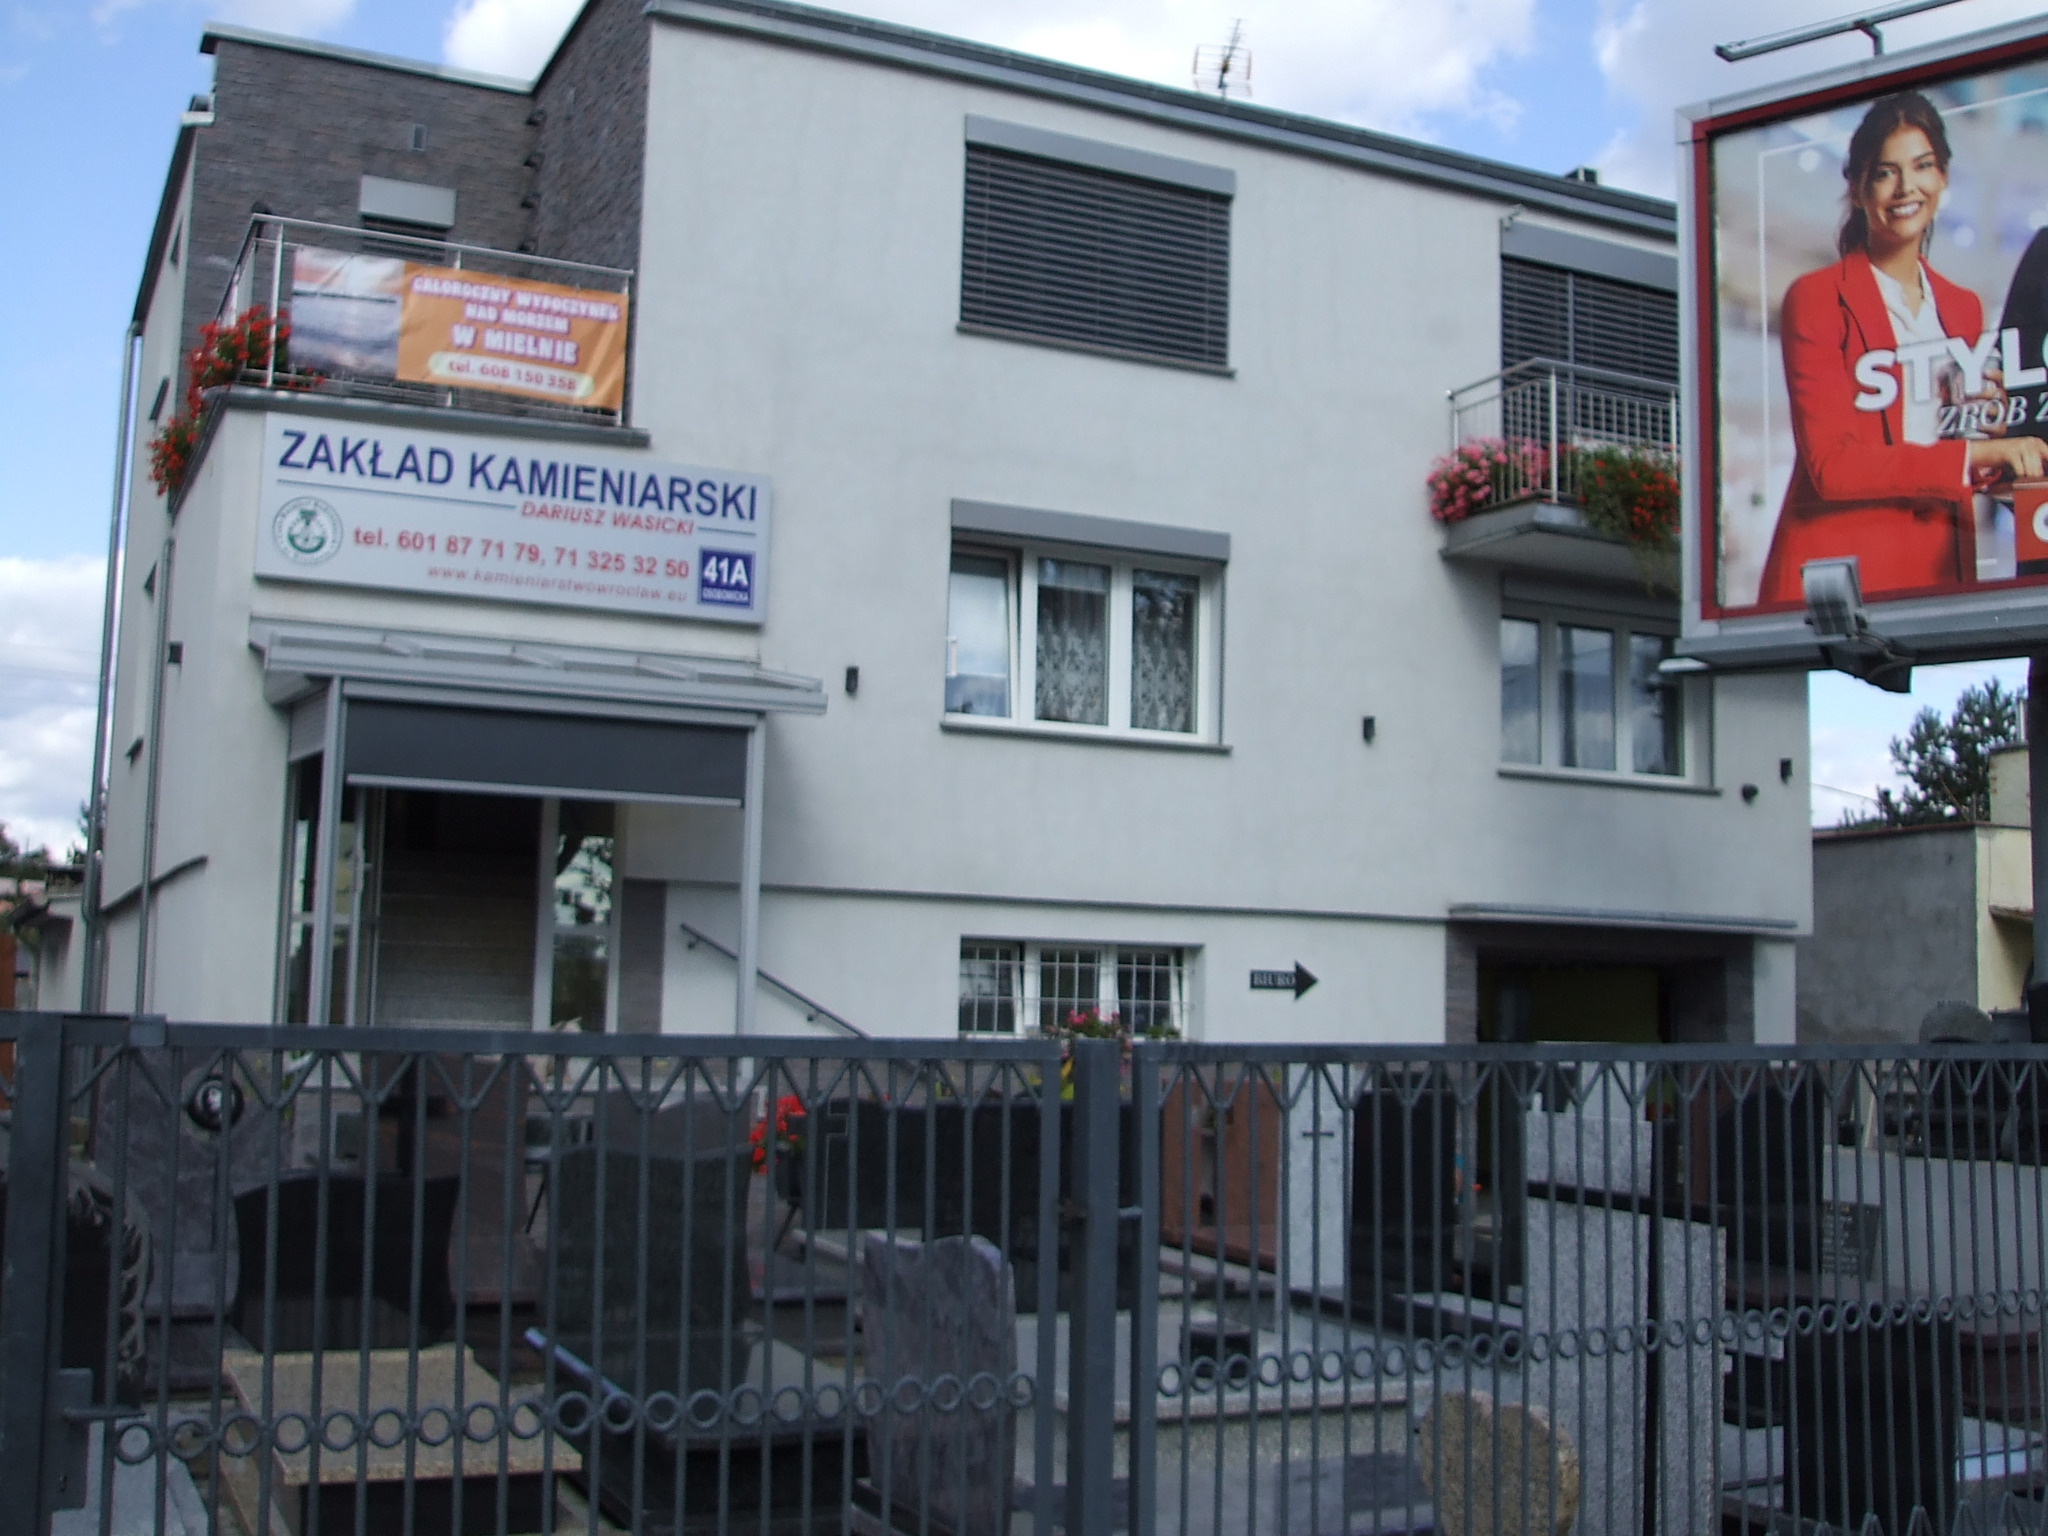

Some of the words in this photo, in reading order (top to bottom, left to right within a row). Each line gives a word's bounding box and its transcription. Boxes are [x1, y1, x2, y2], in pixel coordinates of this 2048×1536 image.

[465, 302, 499, 322] NAD
[501, 308, 570, 334] MORZEM
[515, 290, 620, 321] WYPOCZYNEK
[452, 323, 477, 348] W
[484, 328, 579, 365] MIELNIE
[448, 360, 474, 373] tel.
[517, 366, 544, 384] 150
[1854, 327, 2048, 412] STYL
[278, 429, 455, 485] ZAKŁAD
[469, 451, 756, 521] KAMIENIARSKI
[521, 501, 606, 525] DARIUSZ
[612, 512, 695, 535] WASICKI
[354, 527, 389, 547] tel.
[397, 529, 436, 551] 601
[446, 535, 473, 555] 87
[481, 538, 504, 559] 71
[515, 542, 546, 567] 79,
[555, 546, 578, 567] 71
[587, 550, 626, 572] 325
[633, 555, 657, 576] 32
[665, 559, 690, 580] 50
[703, 555, 748, 586] 41A
